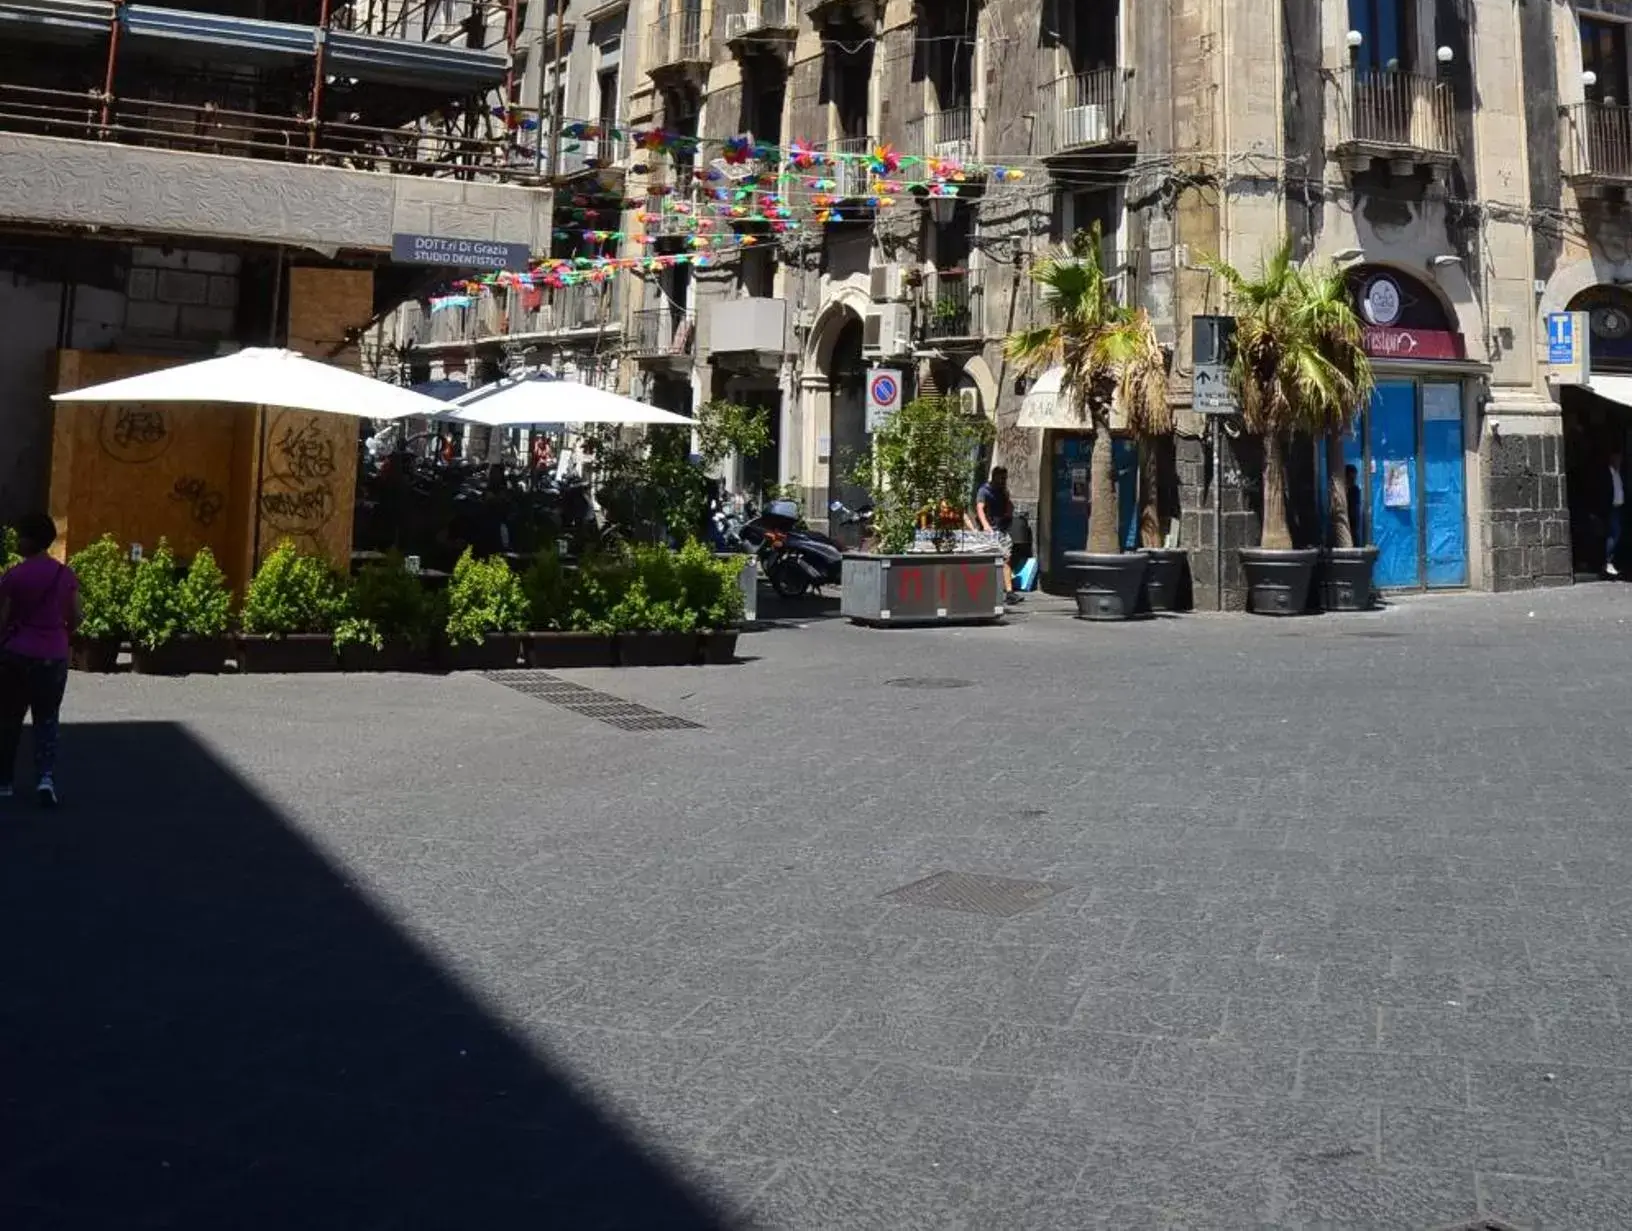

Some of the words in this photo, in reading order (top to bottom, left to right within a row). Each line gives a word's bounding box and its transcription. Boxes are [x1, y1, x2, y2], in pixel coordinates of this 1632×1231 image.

[459, 240, 471, 252] Di
[473, 243, 508, 256] Grazia
[414, 250, 451, 262] STUDIO
[452, 253, 507, 267] DENTISTICO
